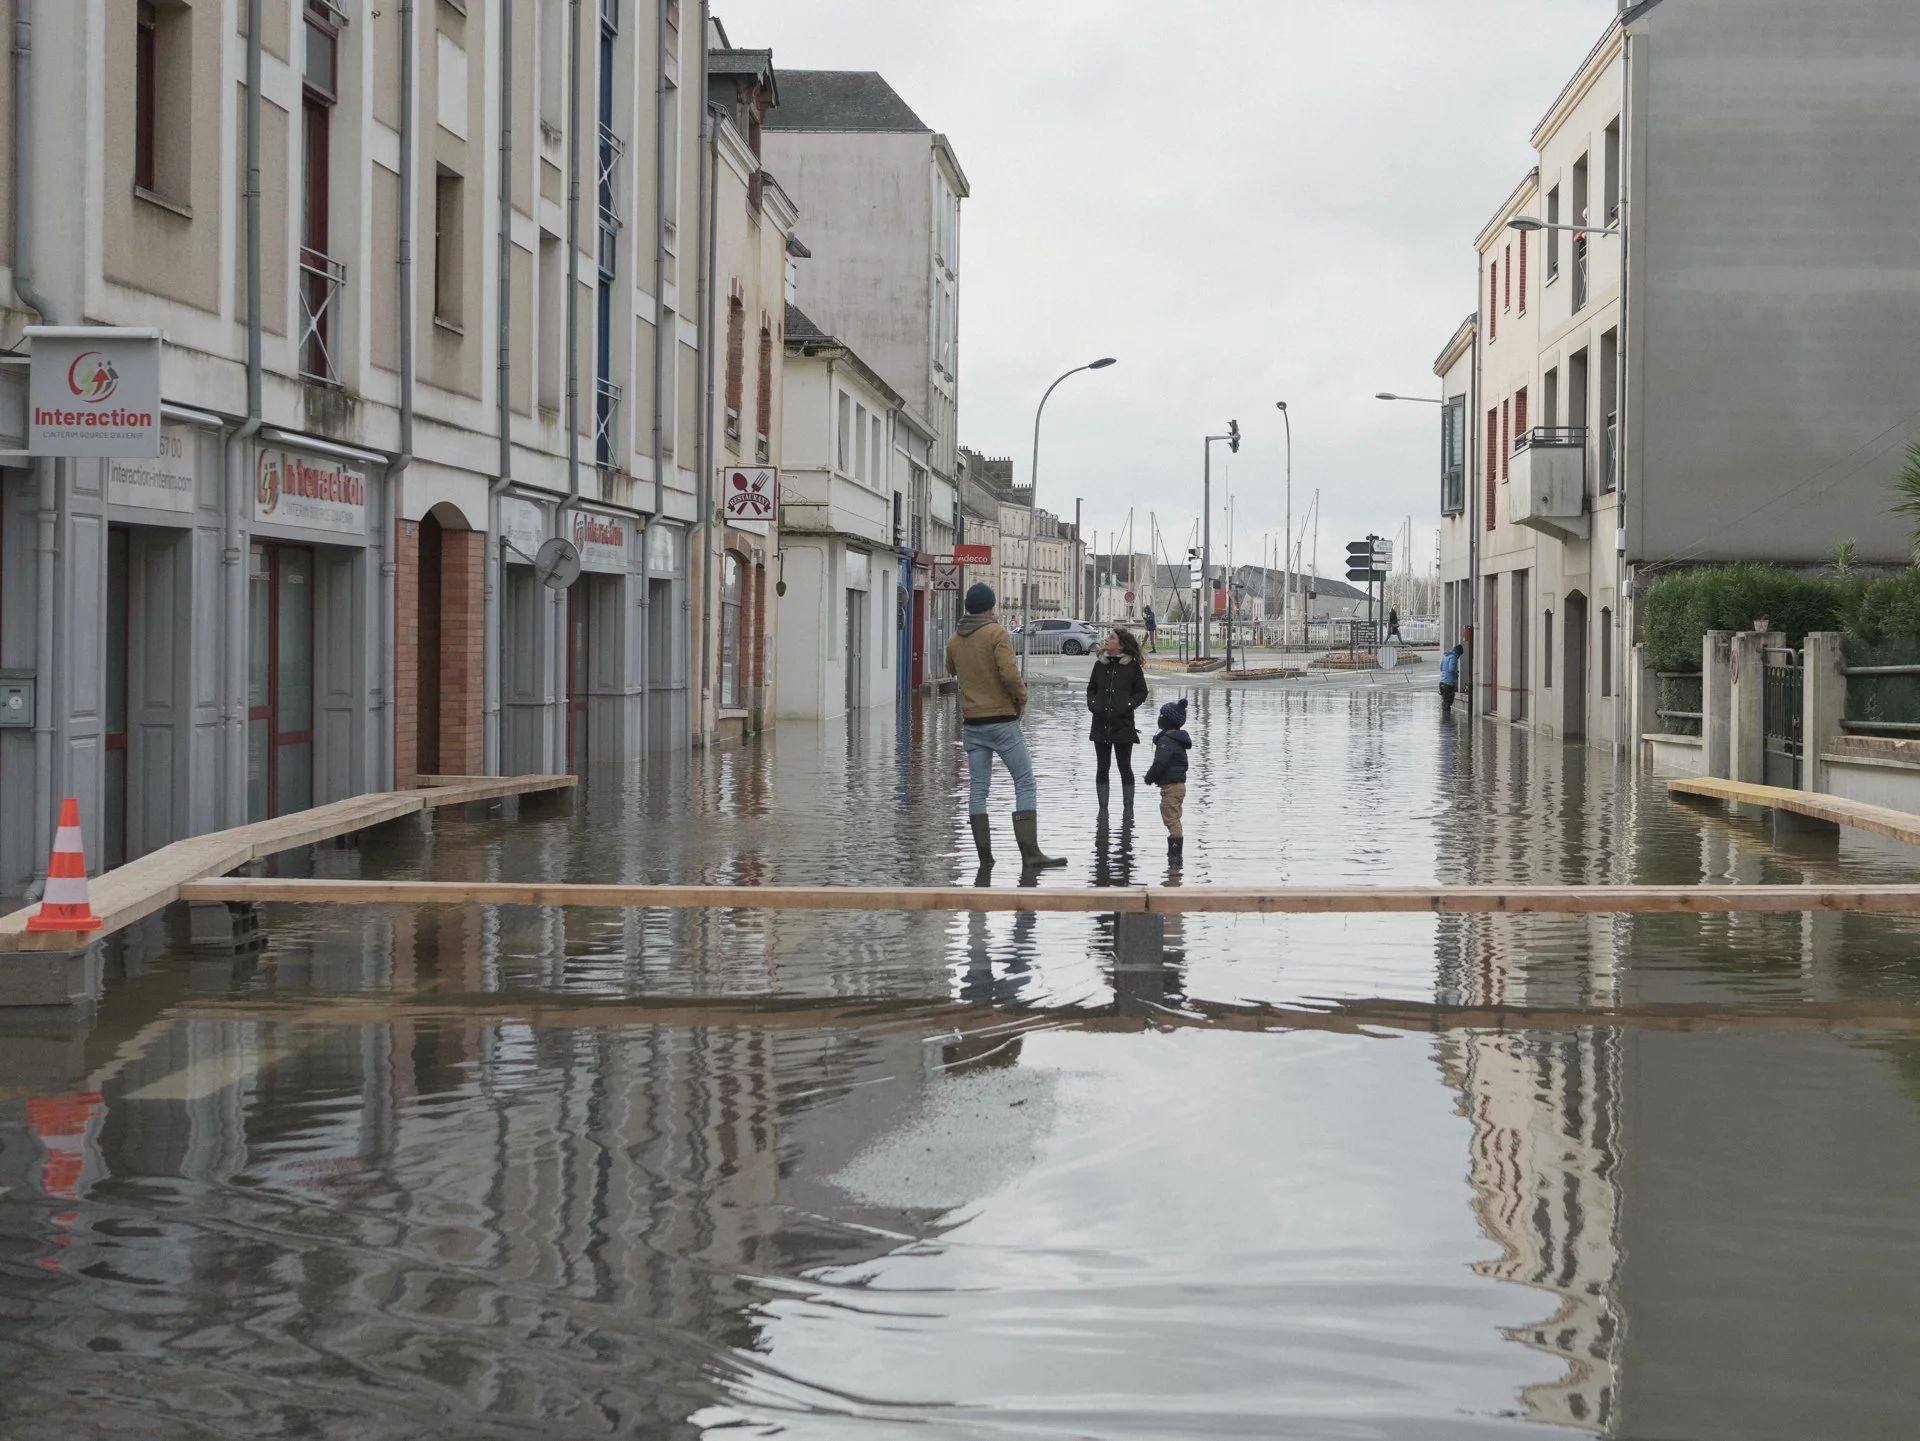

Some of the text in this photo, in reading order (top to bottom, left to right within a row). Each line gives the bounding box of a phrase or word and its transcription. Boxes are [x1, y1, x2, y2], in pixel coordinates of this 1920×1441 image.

[35, 407, 152, 427] Interaction
[80, 431, 108, 439] SOURCE
[282, 453, 364, 506] Interaction
[729, 493, 770, 506] RESTAURANT
